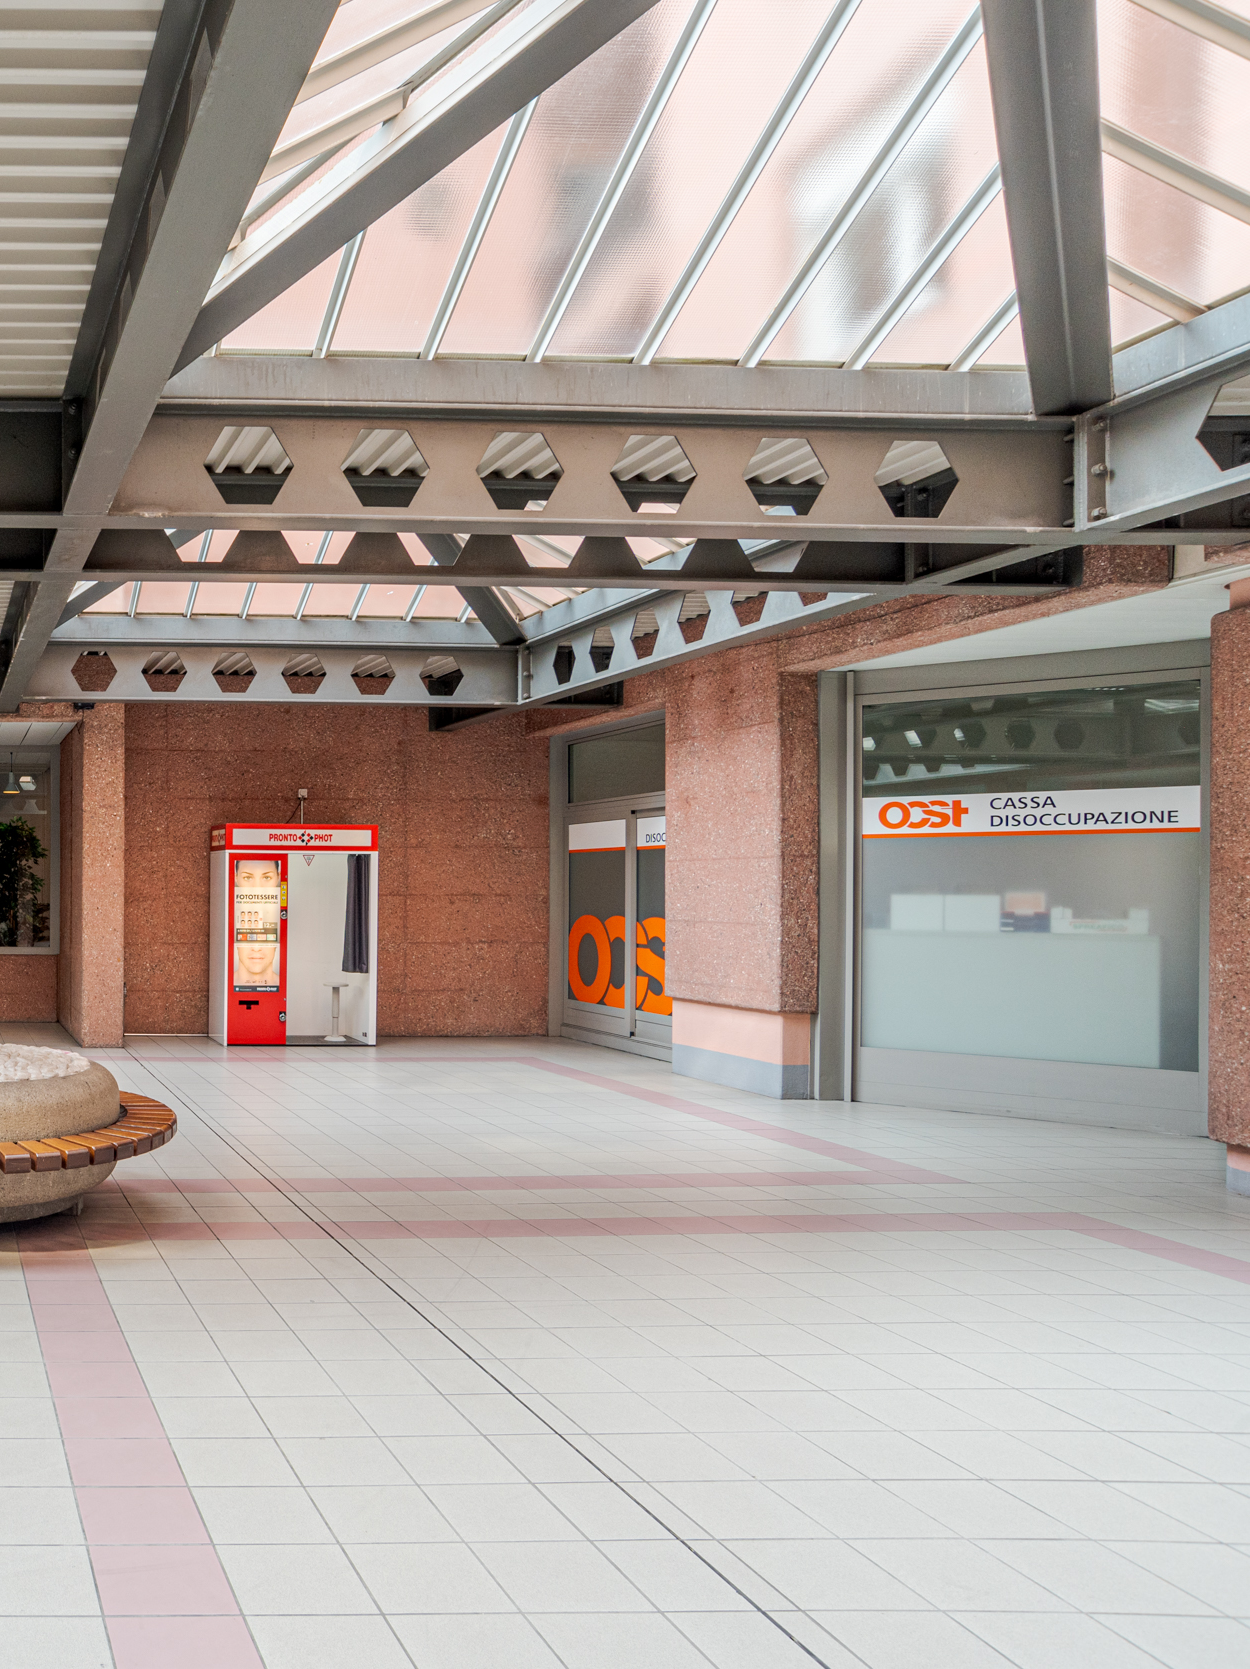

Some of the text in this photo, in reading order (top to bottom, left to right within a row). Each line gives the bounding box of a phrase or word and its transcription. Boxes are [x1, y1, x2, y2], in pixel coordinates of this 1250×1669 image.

[989, 796, 1057, 810] CASSA
[989, 810, 1180, 827] DISOCCUPAZIONE
[269, 833, 333, 842] PRONTO PHOT
